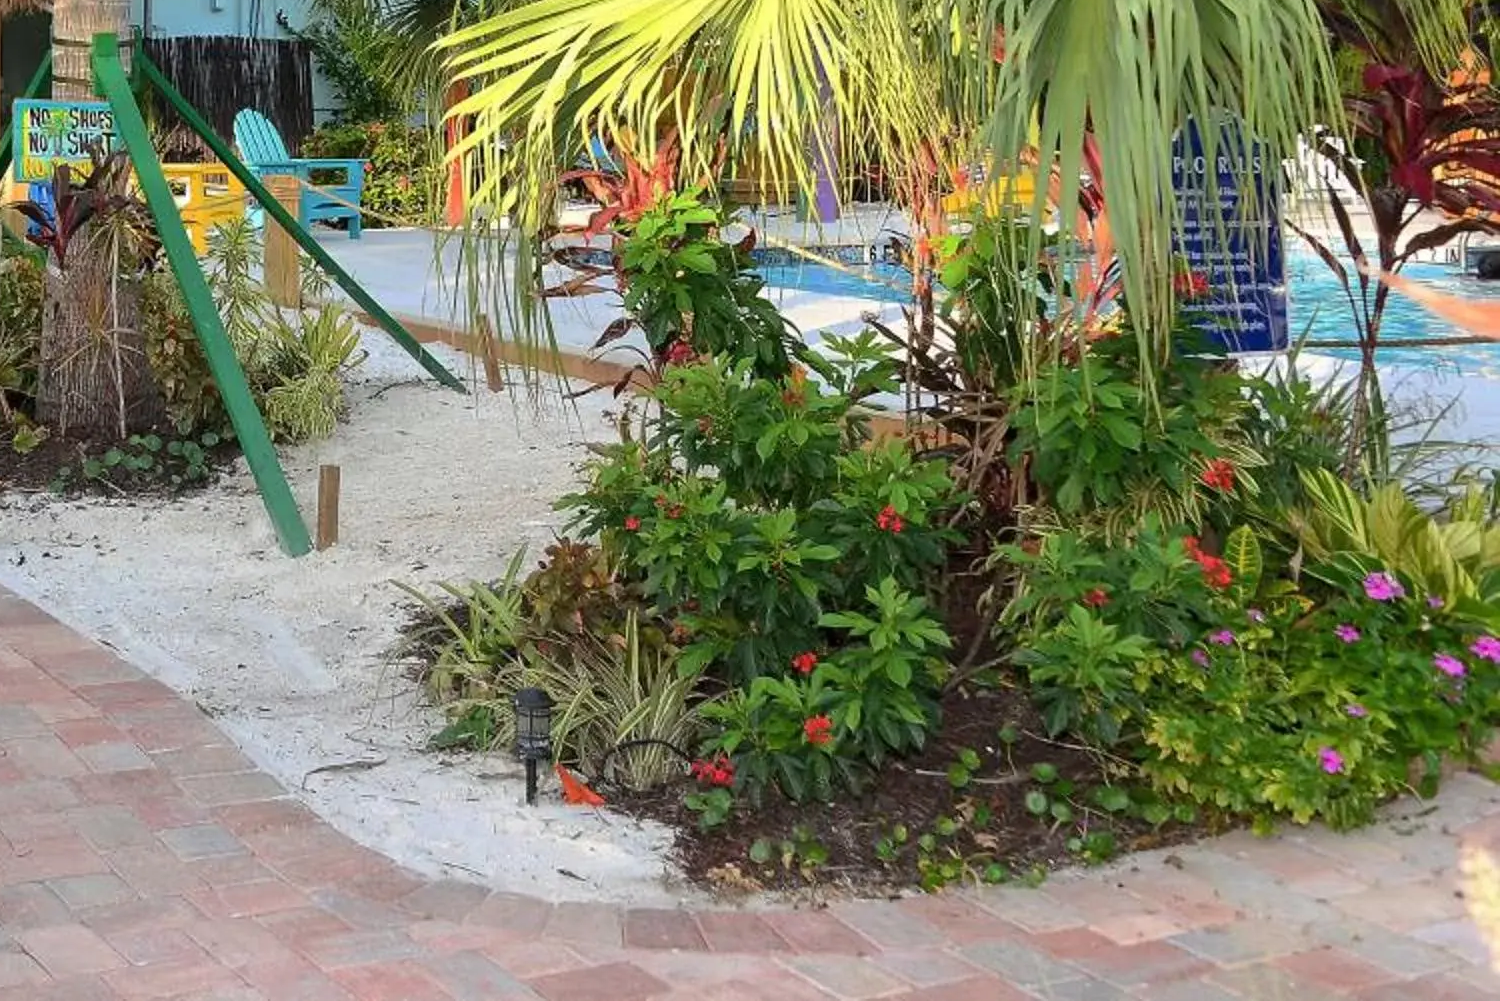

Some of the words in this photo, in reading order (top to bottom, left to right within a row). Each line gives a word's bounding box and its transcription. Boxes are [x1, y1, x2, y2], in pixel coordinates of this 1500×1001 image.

[30, 108, 51, 128] NO
[69, 107, 113, 129] SHOES
[30, 132, 49, 154] NO
[68, 131, 117, 156] SHRT
[25, 158, 45, 177] NO
[1173, 157, 1213, 174] PO
[1218, 157, 1261, 174] RLS
